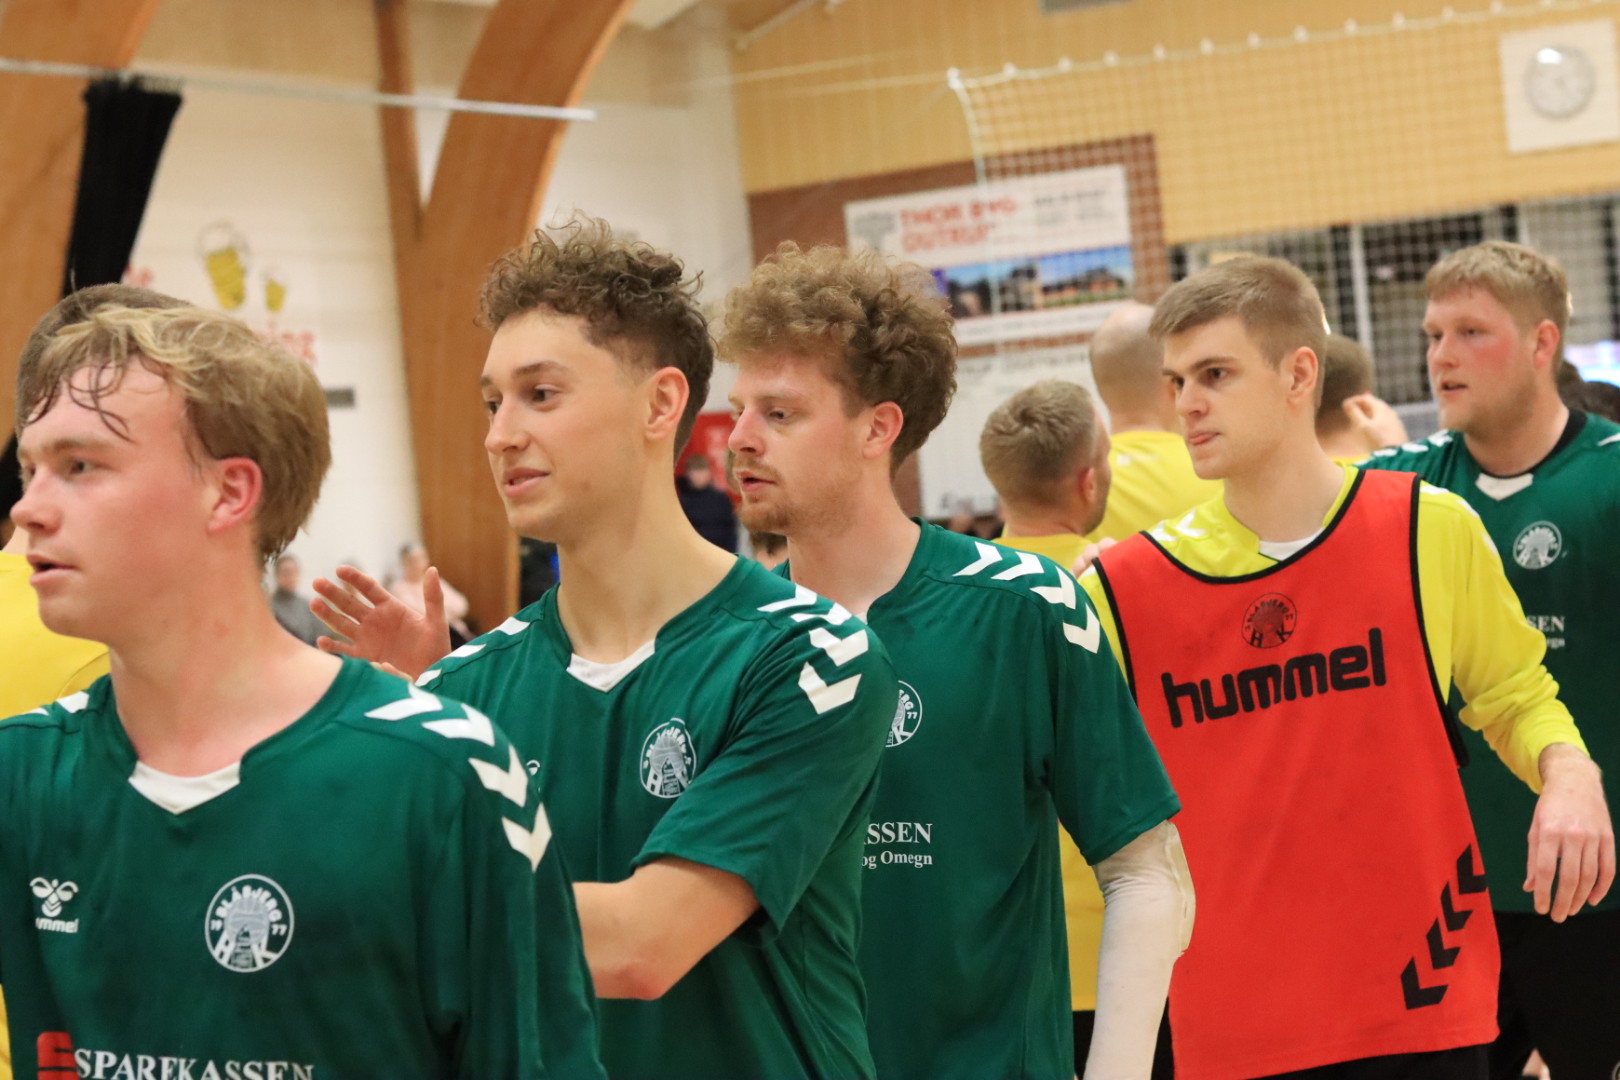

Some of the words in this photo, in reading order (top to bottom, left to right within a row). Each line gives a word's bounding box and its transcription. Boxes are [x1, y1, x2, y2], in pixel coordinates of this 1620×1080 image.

[1161, 627, 1387, 728] hummel
[864, 822, 933, 845] SSEN
[881, 850, 933, 867] Omegn
[74, 1047, 315, 1080] SPAREKASSEN
